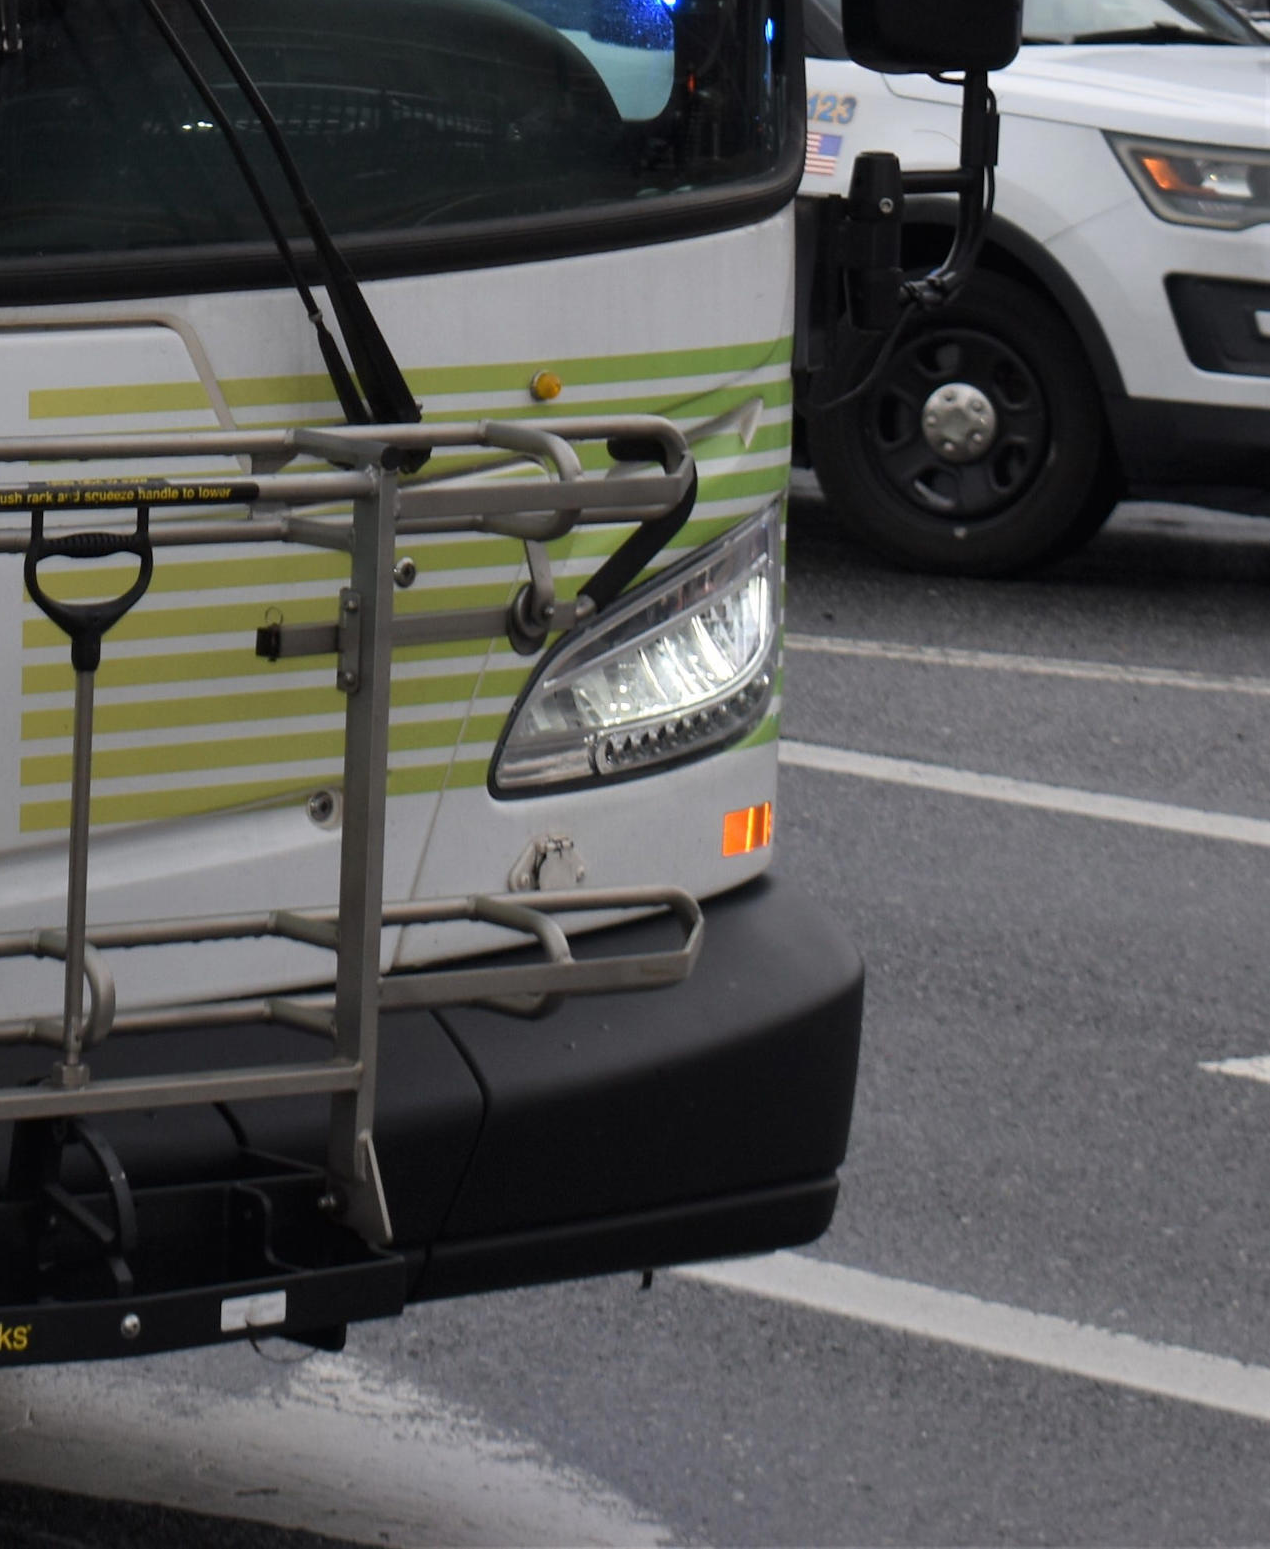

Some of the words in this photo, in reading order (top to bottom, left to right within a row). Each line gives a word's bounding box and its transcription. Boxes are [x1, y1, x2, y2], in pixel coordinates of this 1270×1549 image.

[27, 488, 53, 503] rack
[84, 488, 135, 504] squeeze
[138, 485, 180, 501] handle
[182, 486, 195, 499] to
[198, 486, 232, 499] lower
